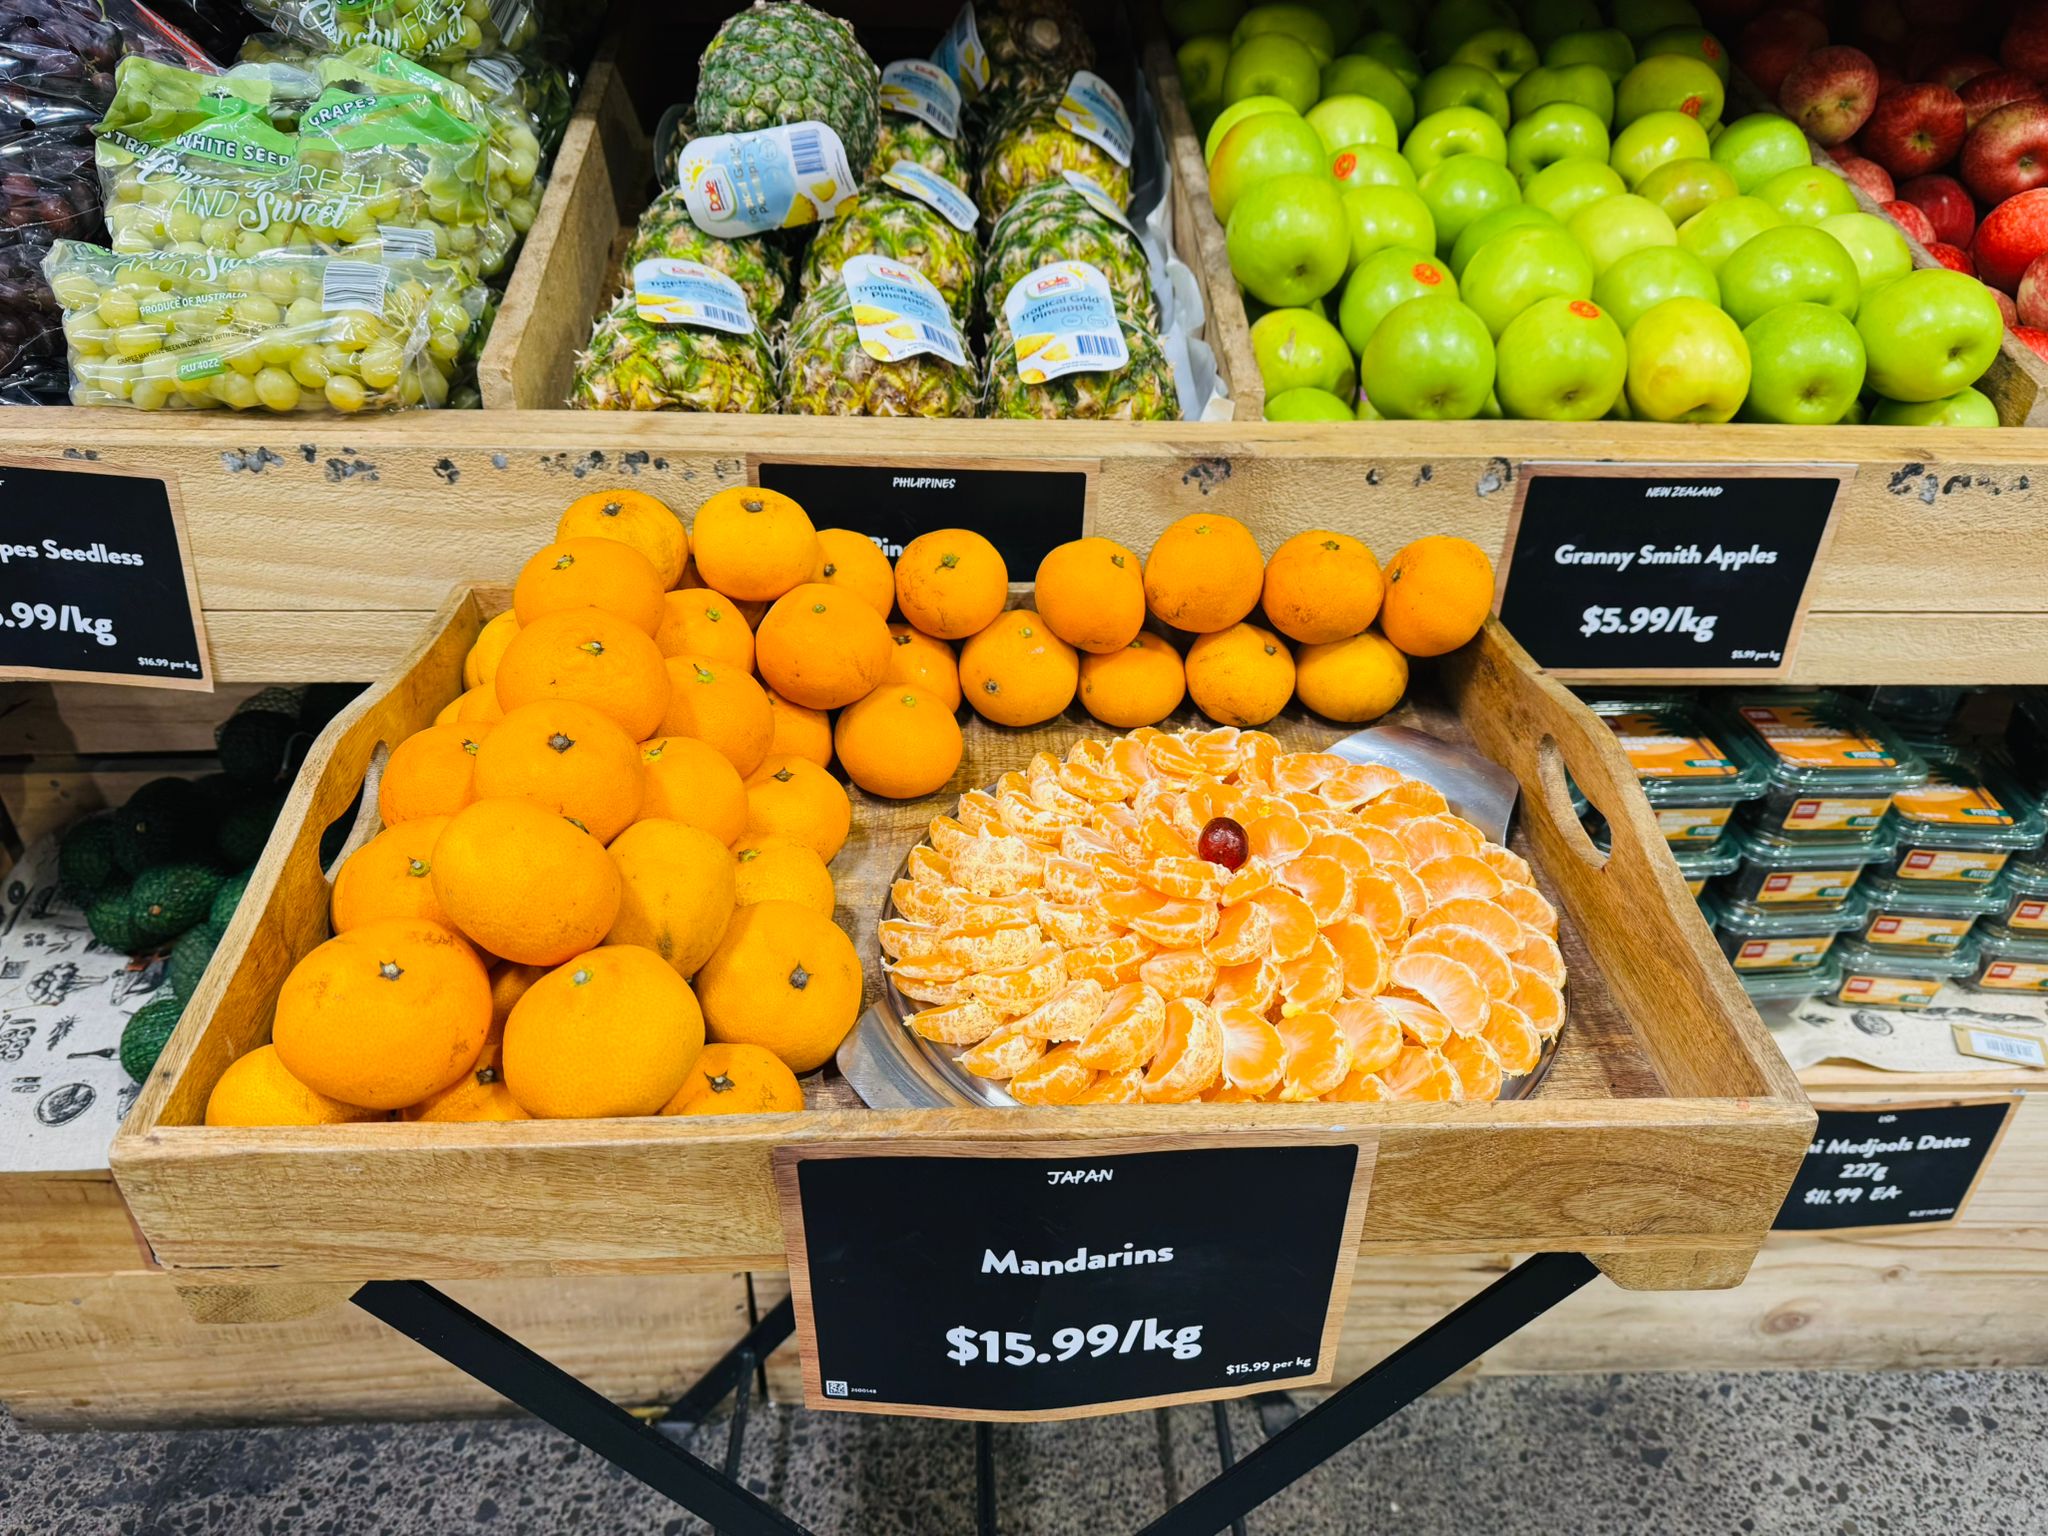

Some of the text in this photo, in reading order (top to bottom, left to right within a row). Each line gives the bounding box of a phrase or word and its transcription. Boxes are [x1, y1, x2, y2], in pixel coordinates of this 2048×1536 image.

[175, 132, 294, 169] WHITE SEED
[297, 163, 383, 197] RESH
[170, 187, 360, 233] AND Sweet
[139, 291, 248, 315] PRODUCE OF AUSTRALIA
[1021, 295, 1100, 322] Tropical Gold
[1032, 303, 1095, 323] Pineapple
[892, 476, 956, 489] PHILIPPINES
[1646, 486, 1724, 498] NEW ZEALAND
[0, 539, 144, 567] pes Seedless
[1554, 544, 1778, 572] Granny Smith Apples
[1580, 605, 1718, 643] $5.99/kg
[138, 656, 199, 672] $16.99 per kg
[1826, 1136, 1914, 1159] Medjools
[1916, 1134, 1972, 1151] Dates
[1047, 1168, 1114, 1185] JAPAN
[1838, 1163, 1889, 1182] 227g
[981, 1242, 1174, 1276] Mandarins
[945, 1317, 1204, 1367] $15.99/kg
[1226, 1356, 1312, 1376] $15.99 per kg
